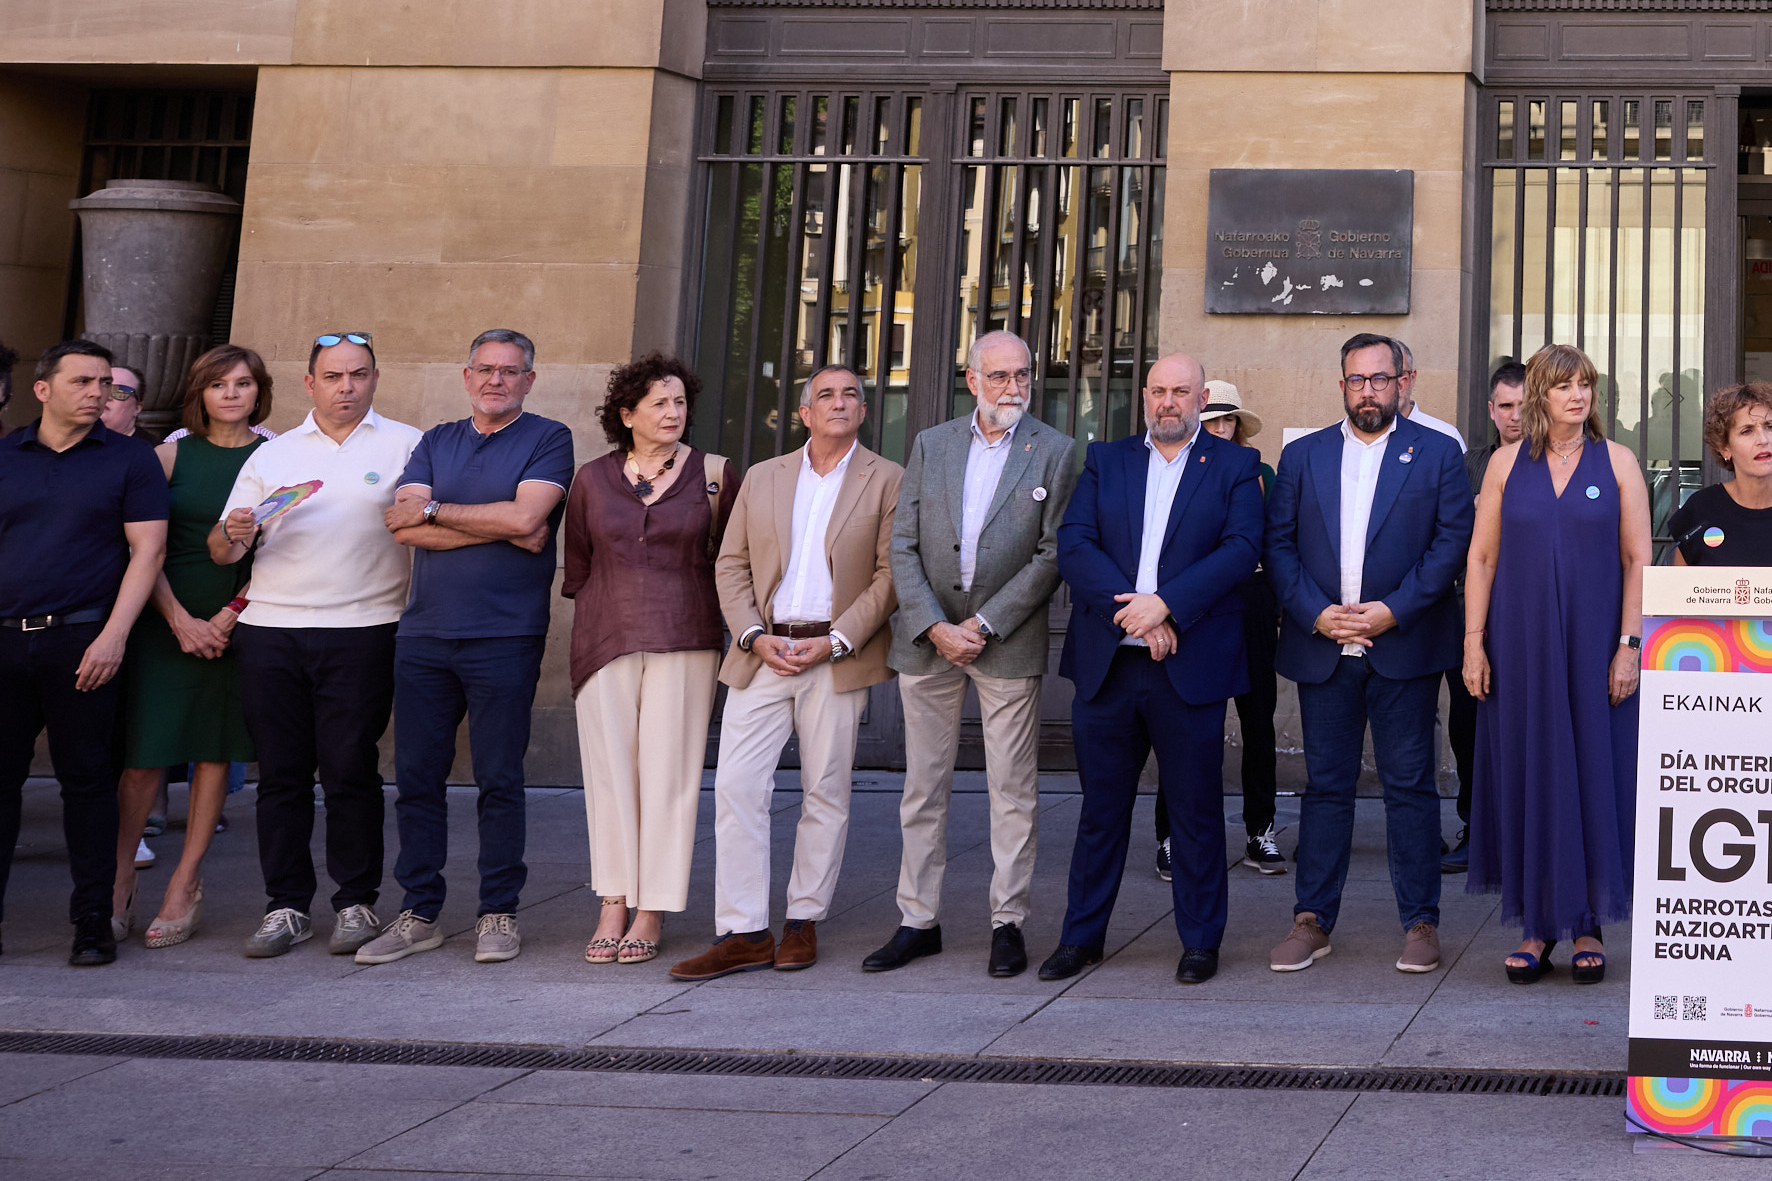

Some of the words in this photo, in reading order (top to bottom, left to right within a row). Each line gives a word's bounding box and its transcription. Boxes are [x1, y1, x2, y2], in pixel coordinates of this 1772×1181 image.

[1213, 229, 1291, 243] Nafarroako
[1328, 229, 1391, 243] Gobierno
[1222, 246, 1290, 259] Gobernua
[1328, 246, 1345, 260] de
[1349, 247, 1403, 260] Navarra
[1693, 586, 1731, 595] Gobierno
[1686, 596, 1697, 604] de
[1698, 596, 1731, 604] Navarra
[1662, 694, 1763, 713] EKAINAK
[1660, 749, 1698, 770] DÍA
[1659, 775, 1701, 792] DEL
[1654, 942, 1732, 961] EGUNA
[1690, 1048, 1751, 1063] NAVARRA
